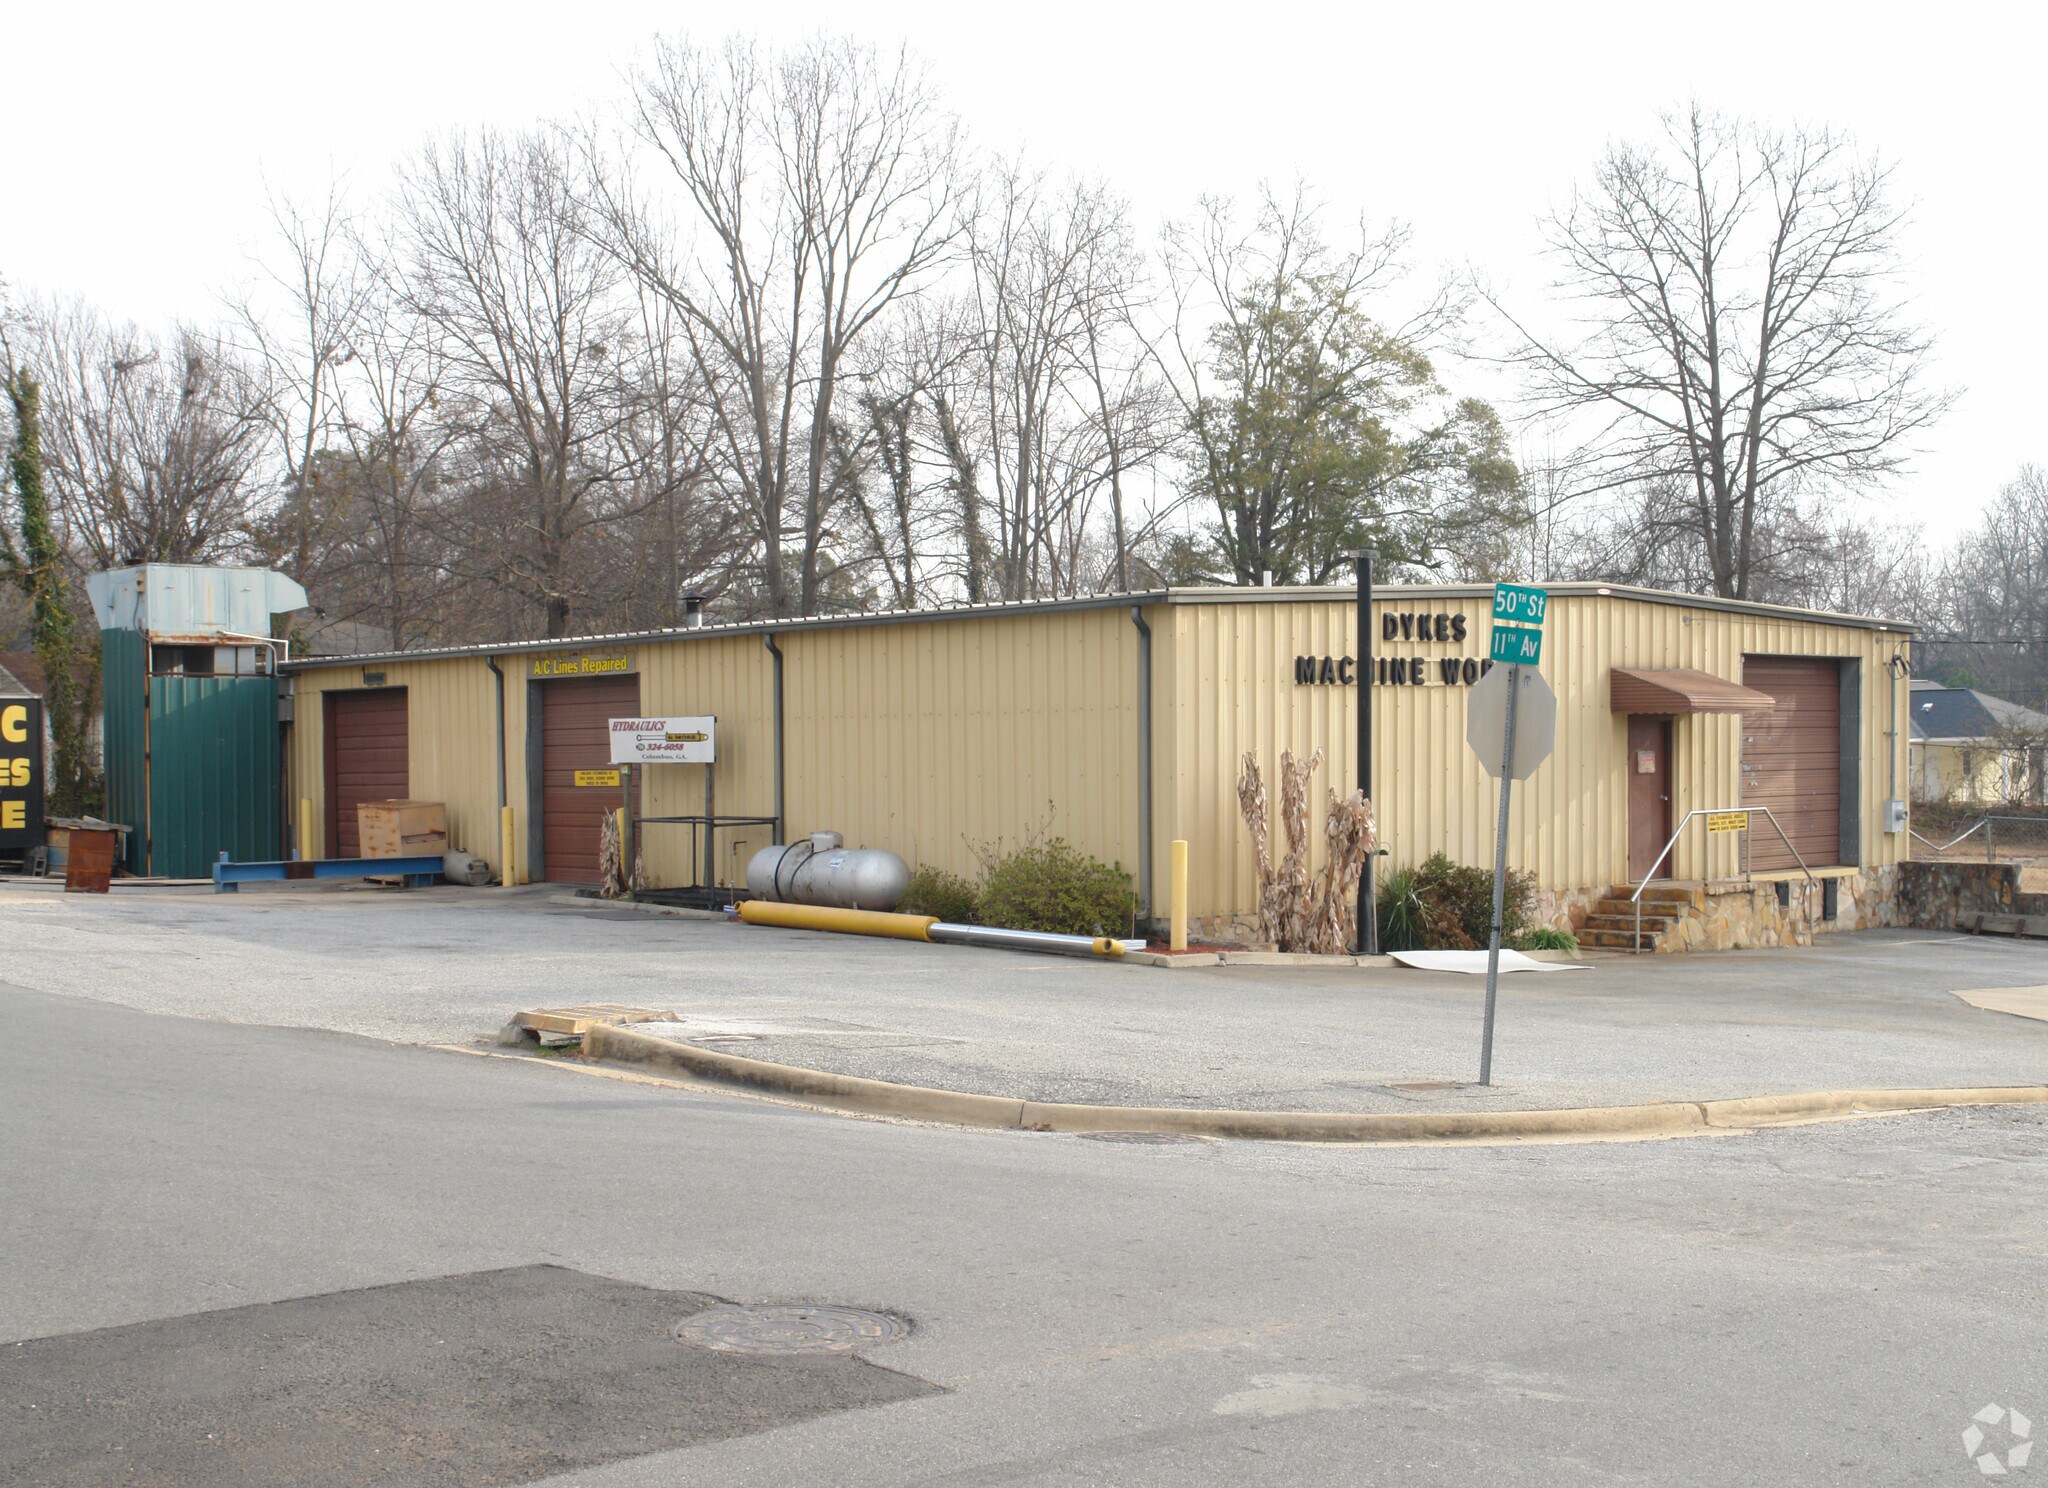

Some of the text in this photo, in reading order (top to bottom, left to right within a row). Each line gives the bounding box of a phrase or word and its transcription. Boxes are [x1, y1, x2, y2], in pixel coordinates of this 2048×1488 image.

[1527, 594, 1545, 618] St
[1382, 612, 1467, 642] DYKES
[533, 654, 628, 676] A/C Lines Repaired
[1296, 655, 1425, 686] MACINE
[1, 705, 27, 743] C
[611, 720, 667, 732] HYDRAULICS
[646, 743, 685, 751] 324-6058
[0, 801, 26, 829] E
